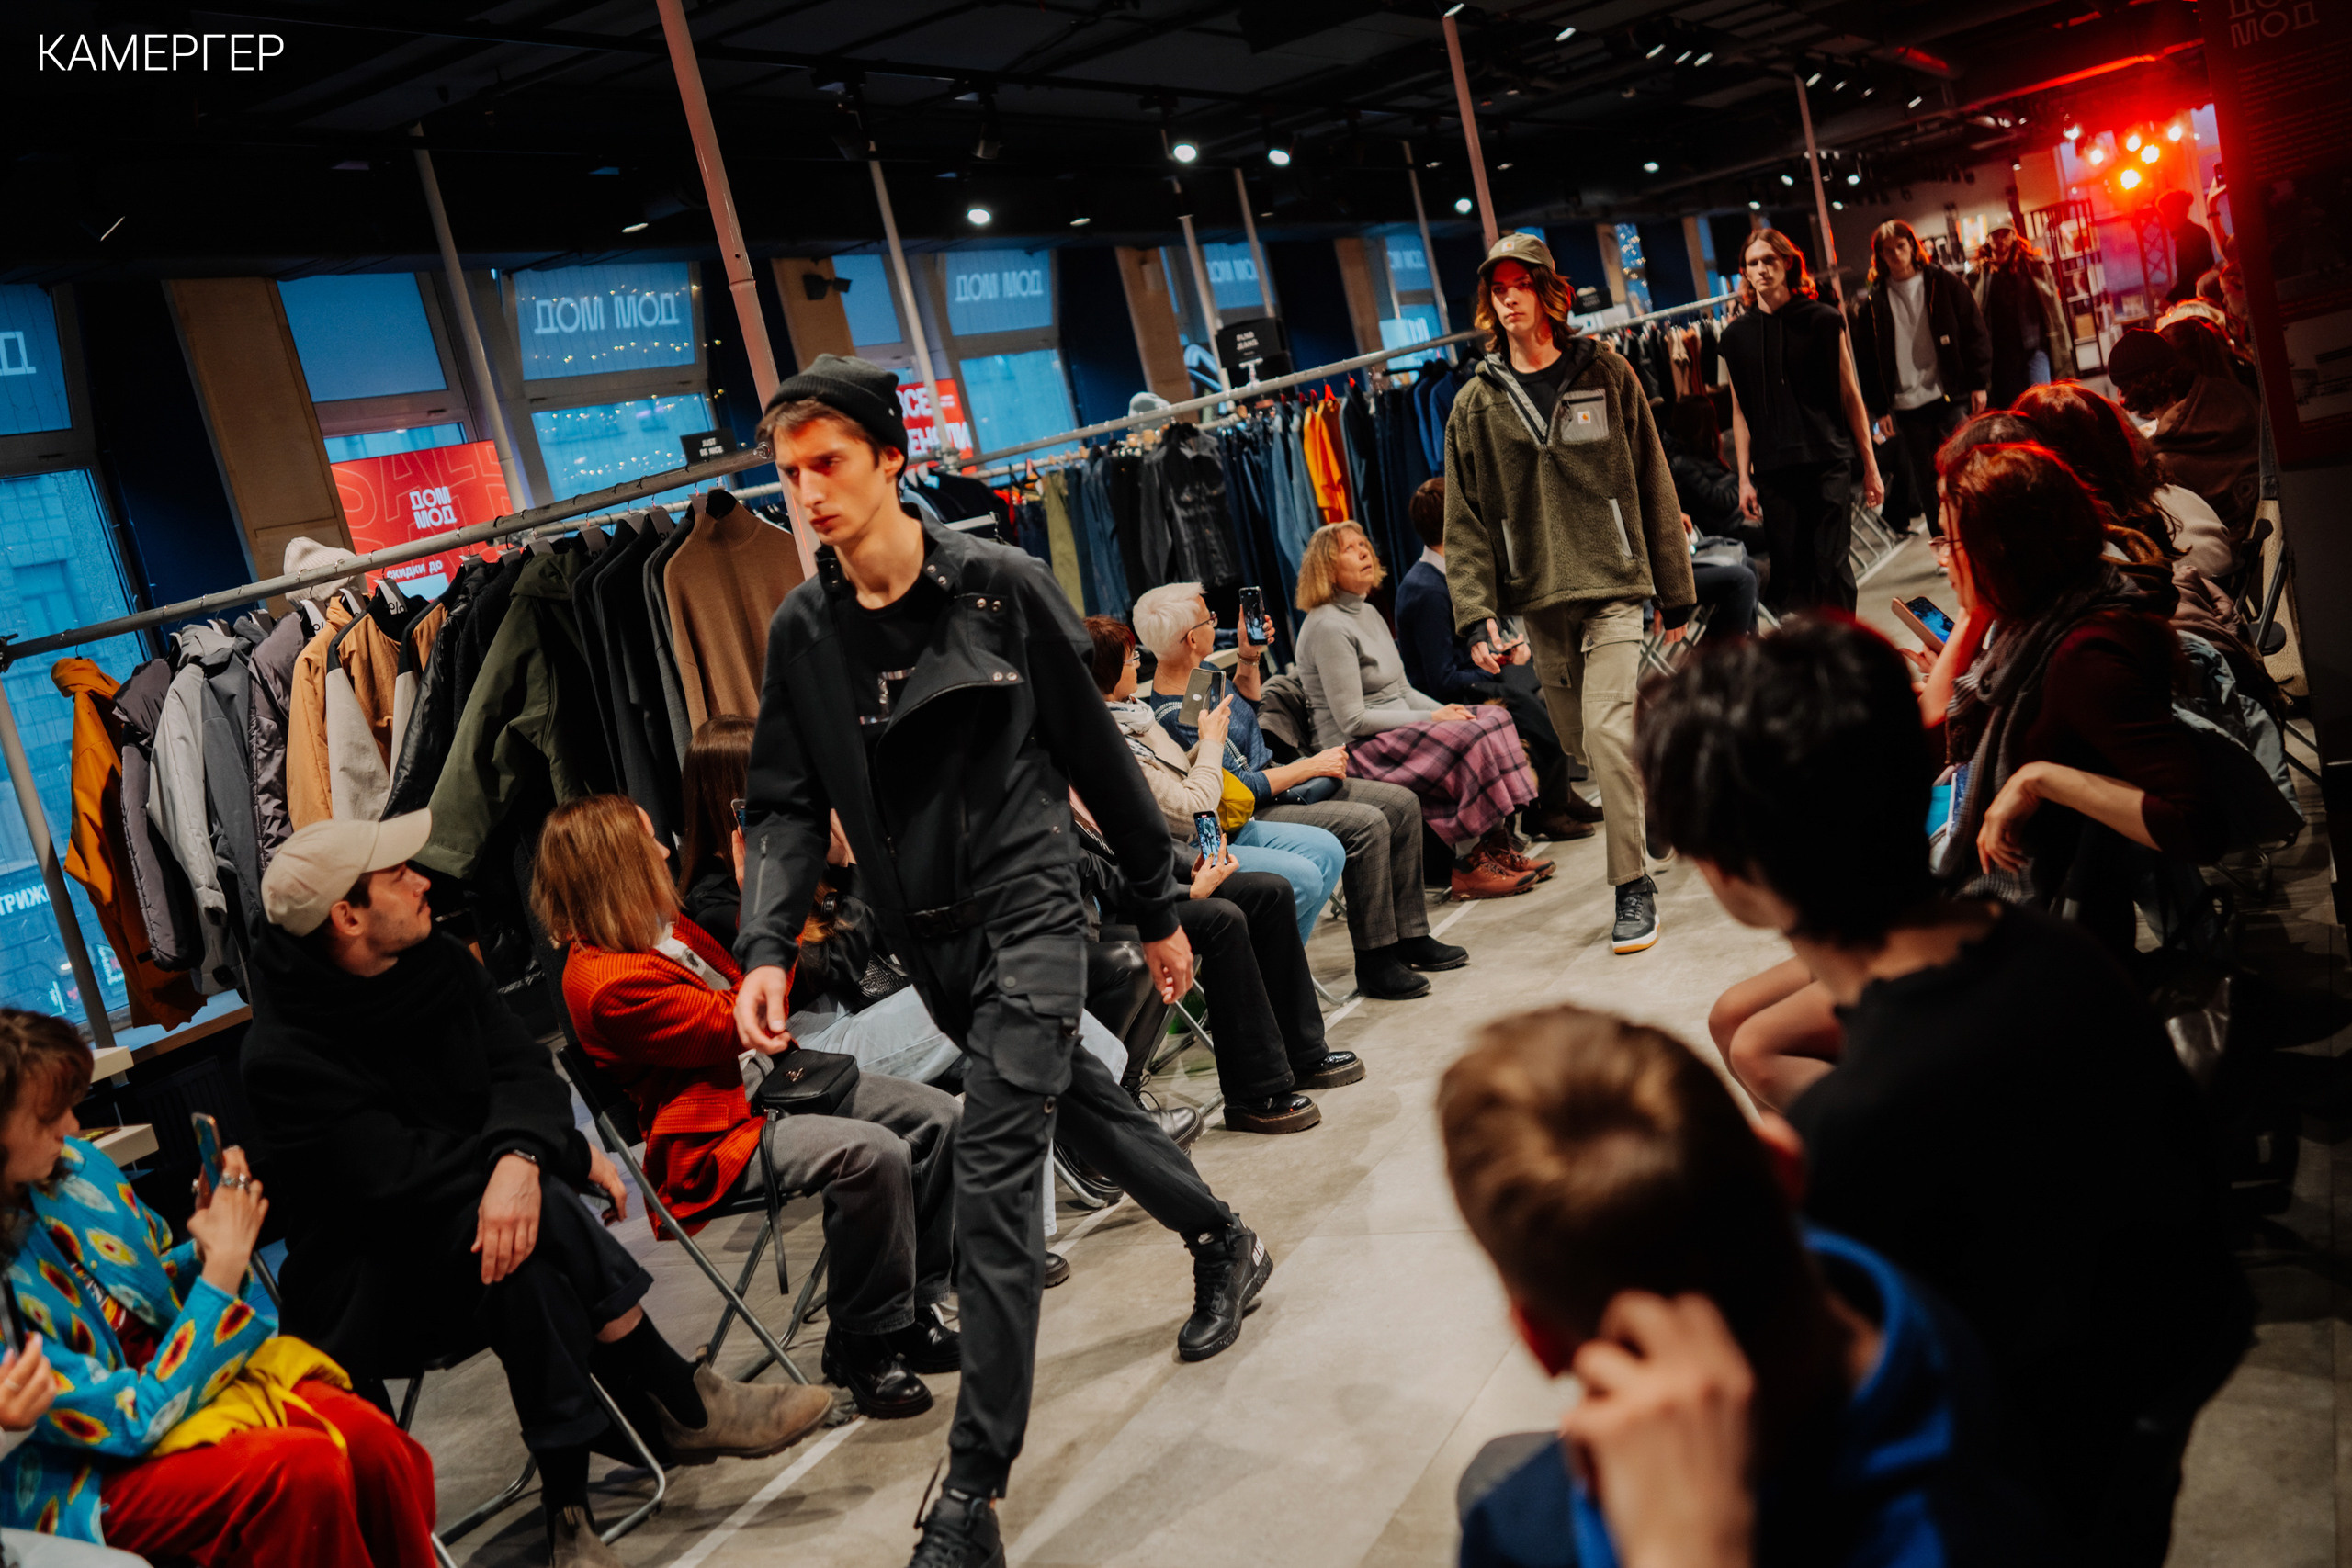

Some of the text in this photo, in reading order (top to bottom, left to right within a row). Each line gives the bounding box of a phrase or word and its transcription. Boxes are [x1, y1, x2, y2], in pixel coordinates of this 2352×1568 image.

[956, 269, 1044, 302] ДОМ МОД
[534, 292, 681, 334] ДОМ МОД
[895, 387, 933, 419] СЕ
[409, 485, 452, 511] ДОМ
[413, 505, 458, 530] МОД
